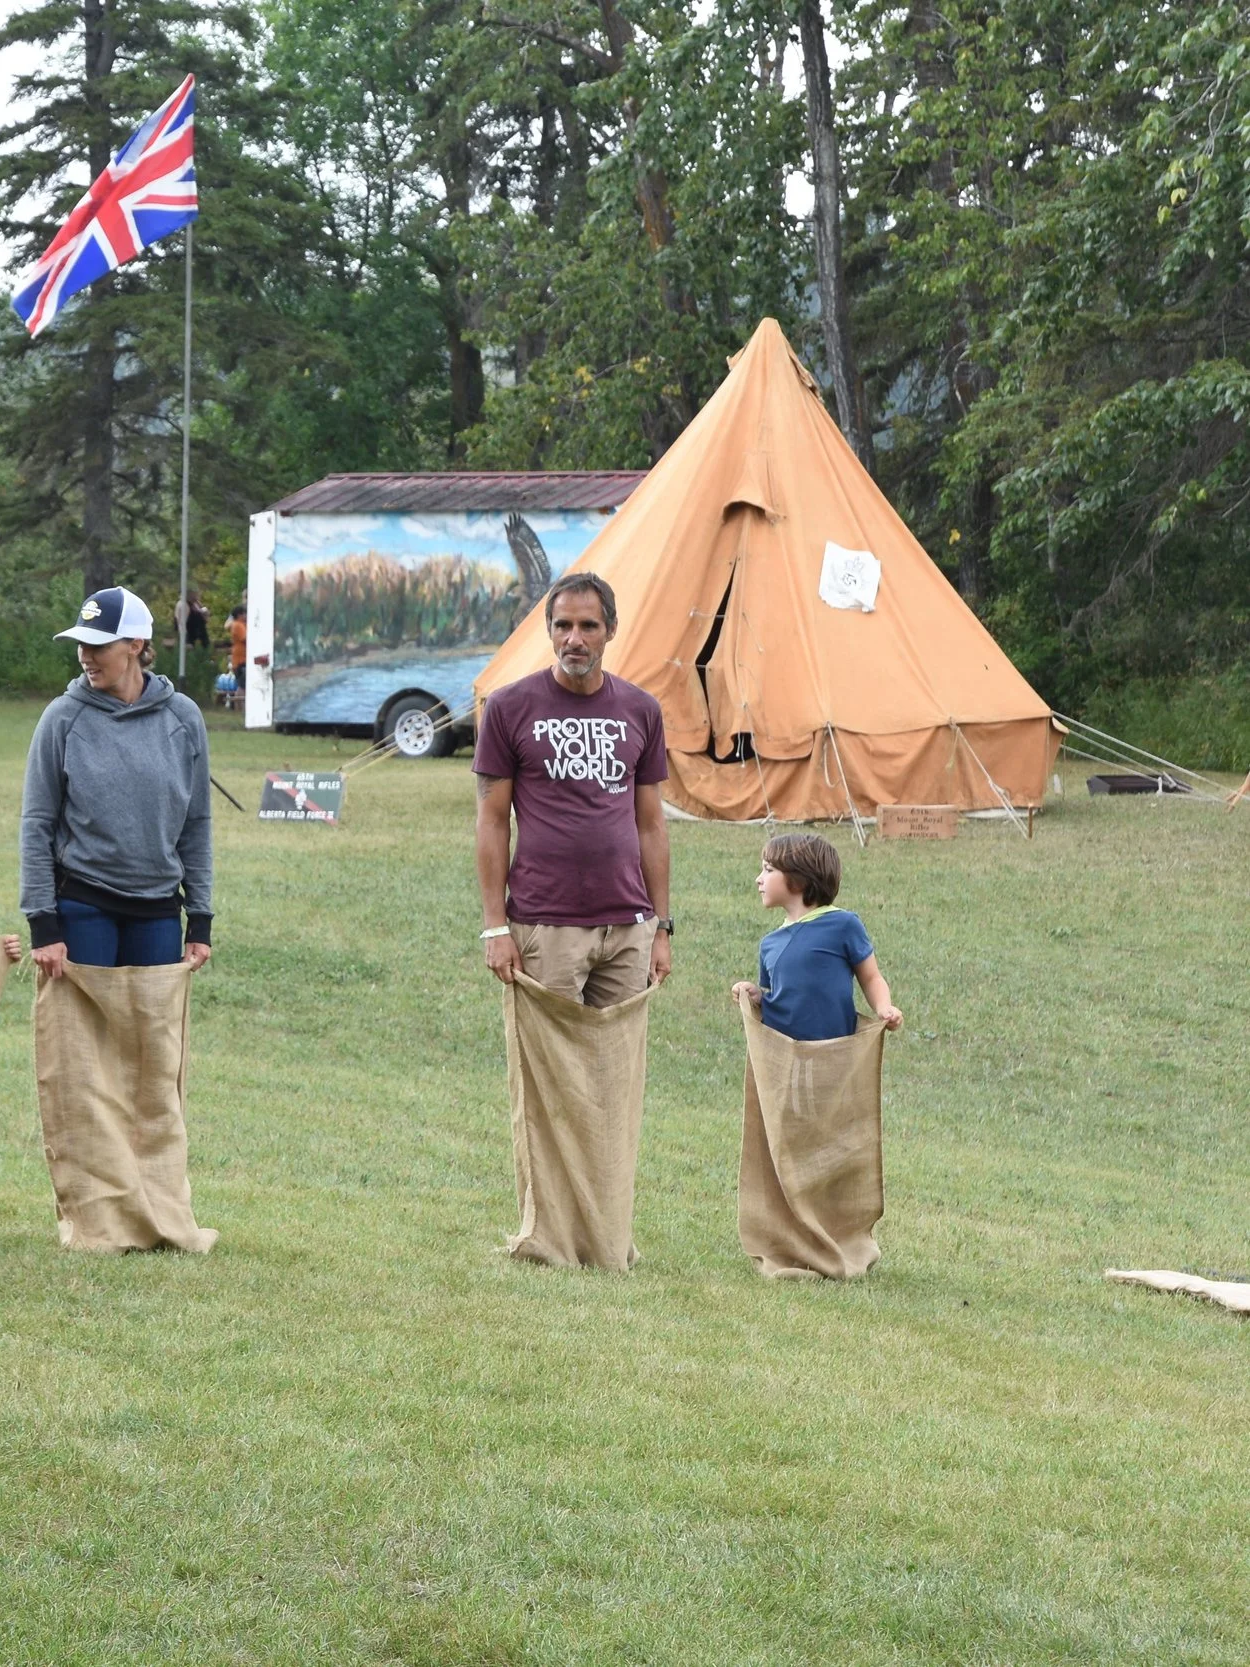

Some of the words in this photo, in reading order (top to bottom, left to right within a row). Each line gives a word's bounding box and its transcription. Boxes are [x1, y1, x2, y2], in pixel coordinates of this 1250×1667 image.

[532, 717, 627, 742] PROTECT
[549, 737, 615, 760] YOUR
[543, 758, 627, 789] WORLD
[272, 781, 293, 790] MOUNT
[295, 781, 315, 790] ROYAL
[318, 781, 341, 790] RIFLES
[258, 810, 286, 819] ALBERTA
[286, 810, 306, 819] FIELD
[306, 810, 327, 819] FORCE
